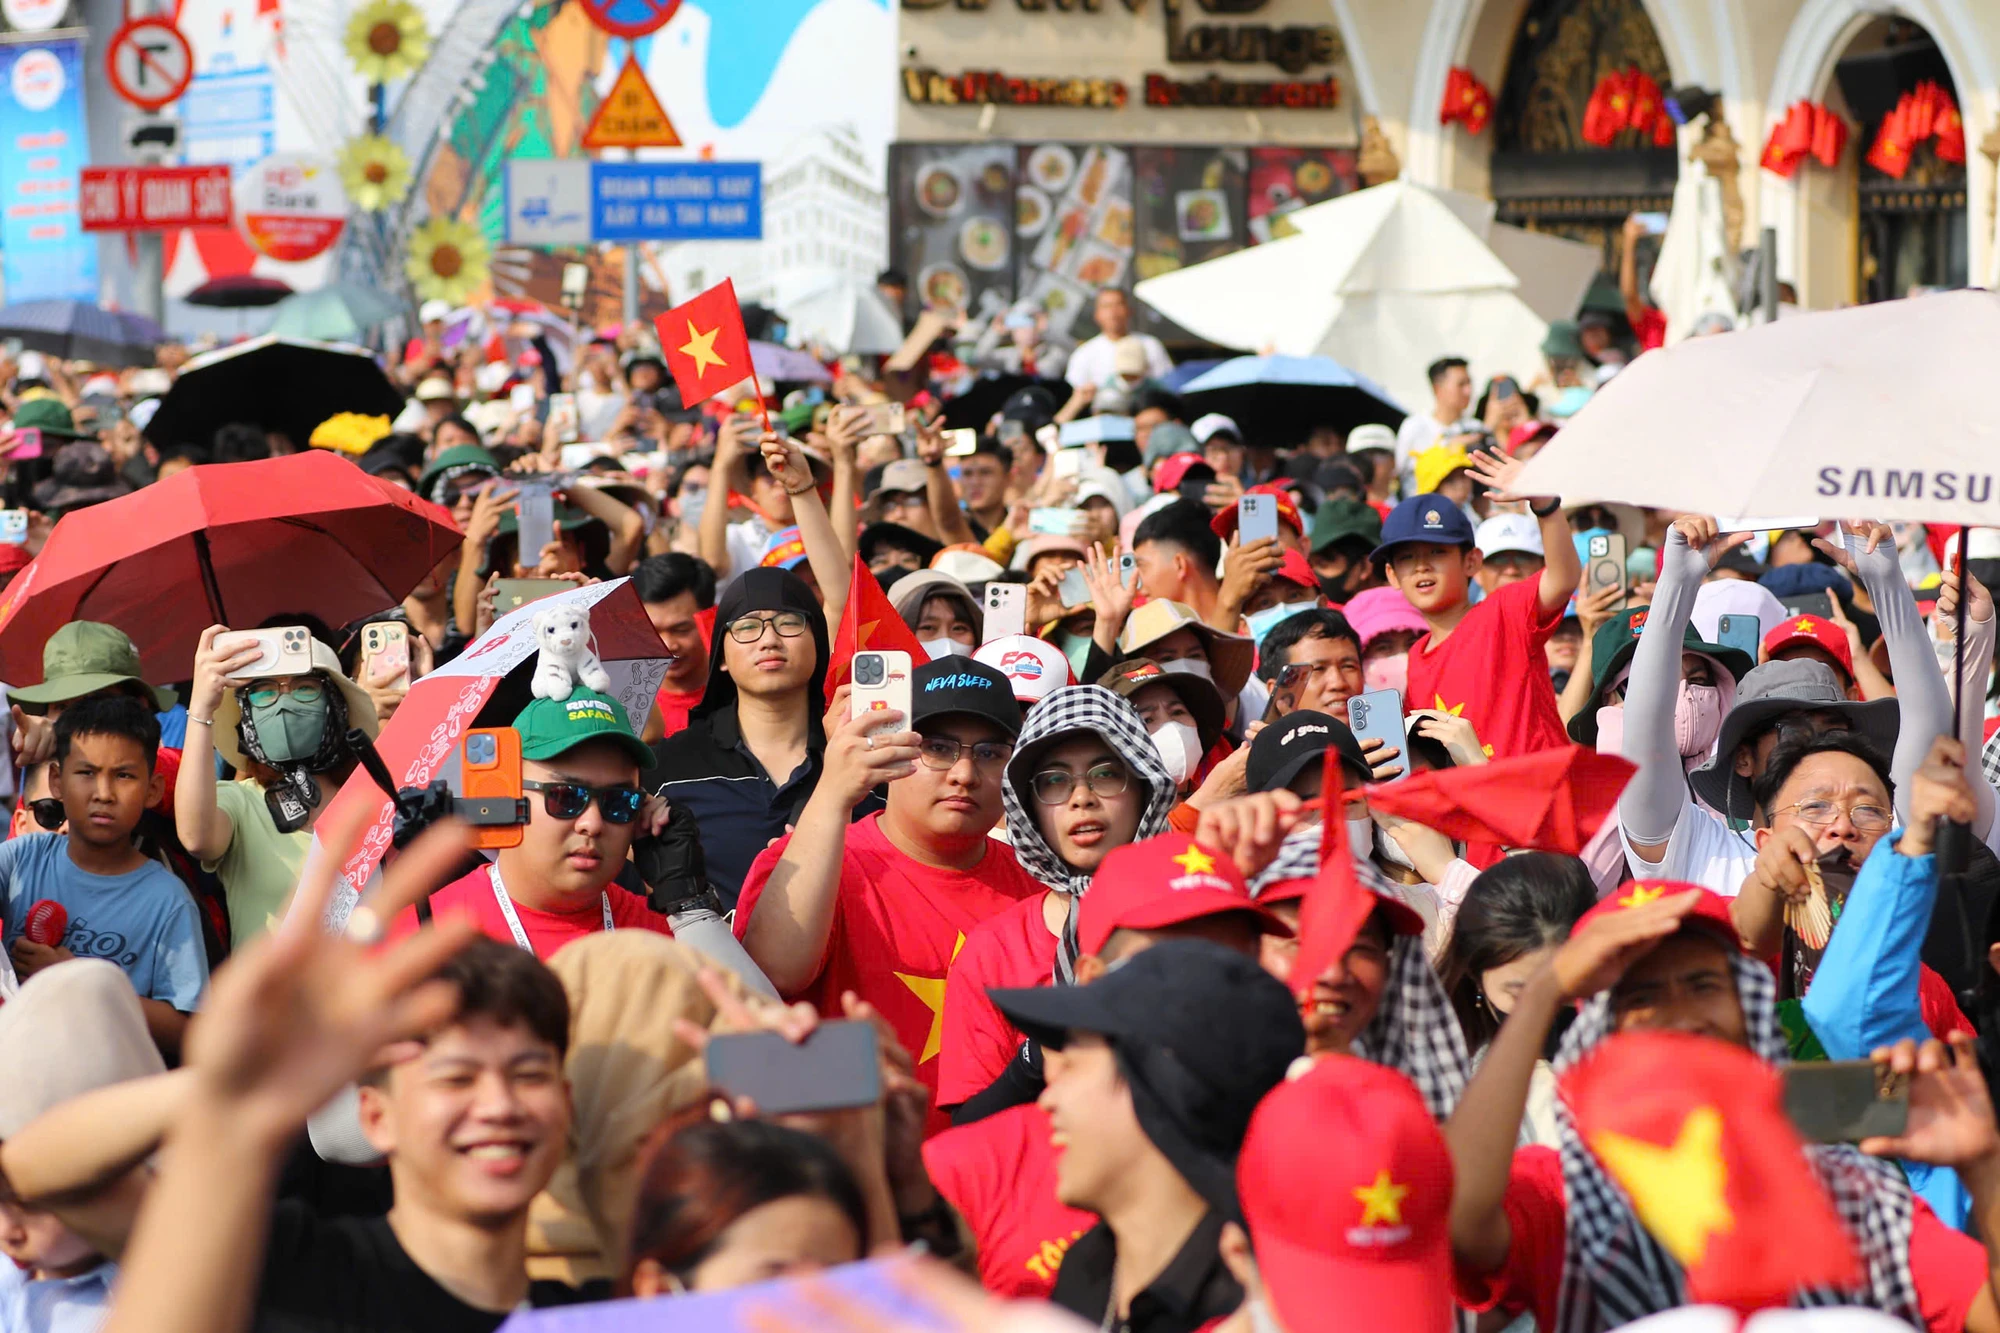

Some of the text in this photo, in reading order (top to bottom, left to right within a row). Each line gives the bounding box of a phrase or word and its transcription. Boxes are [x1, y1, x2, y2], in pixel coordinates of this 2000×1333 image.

[1166, 6, 1340, 74] Lounge
[1817, 466, 2000, 503] SAMSU
[566, 700, 614, 714] RIVER
[568, 709, 617, 724] SAFARI
[1281, 724, 1329, 746] all good
